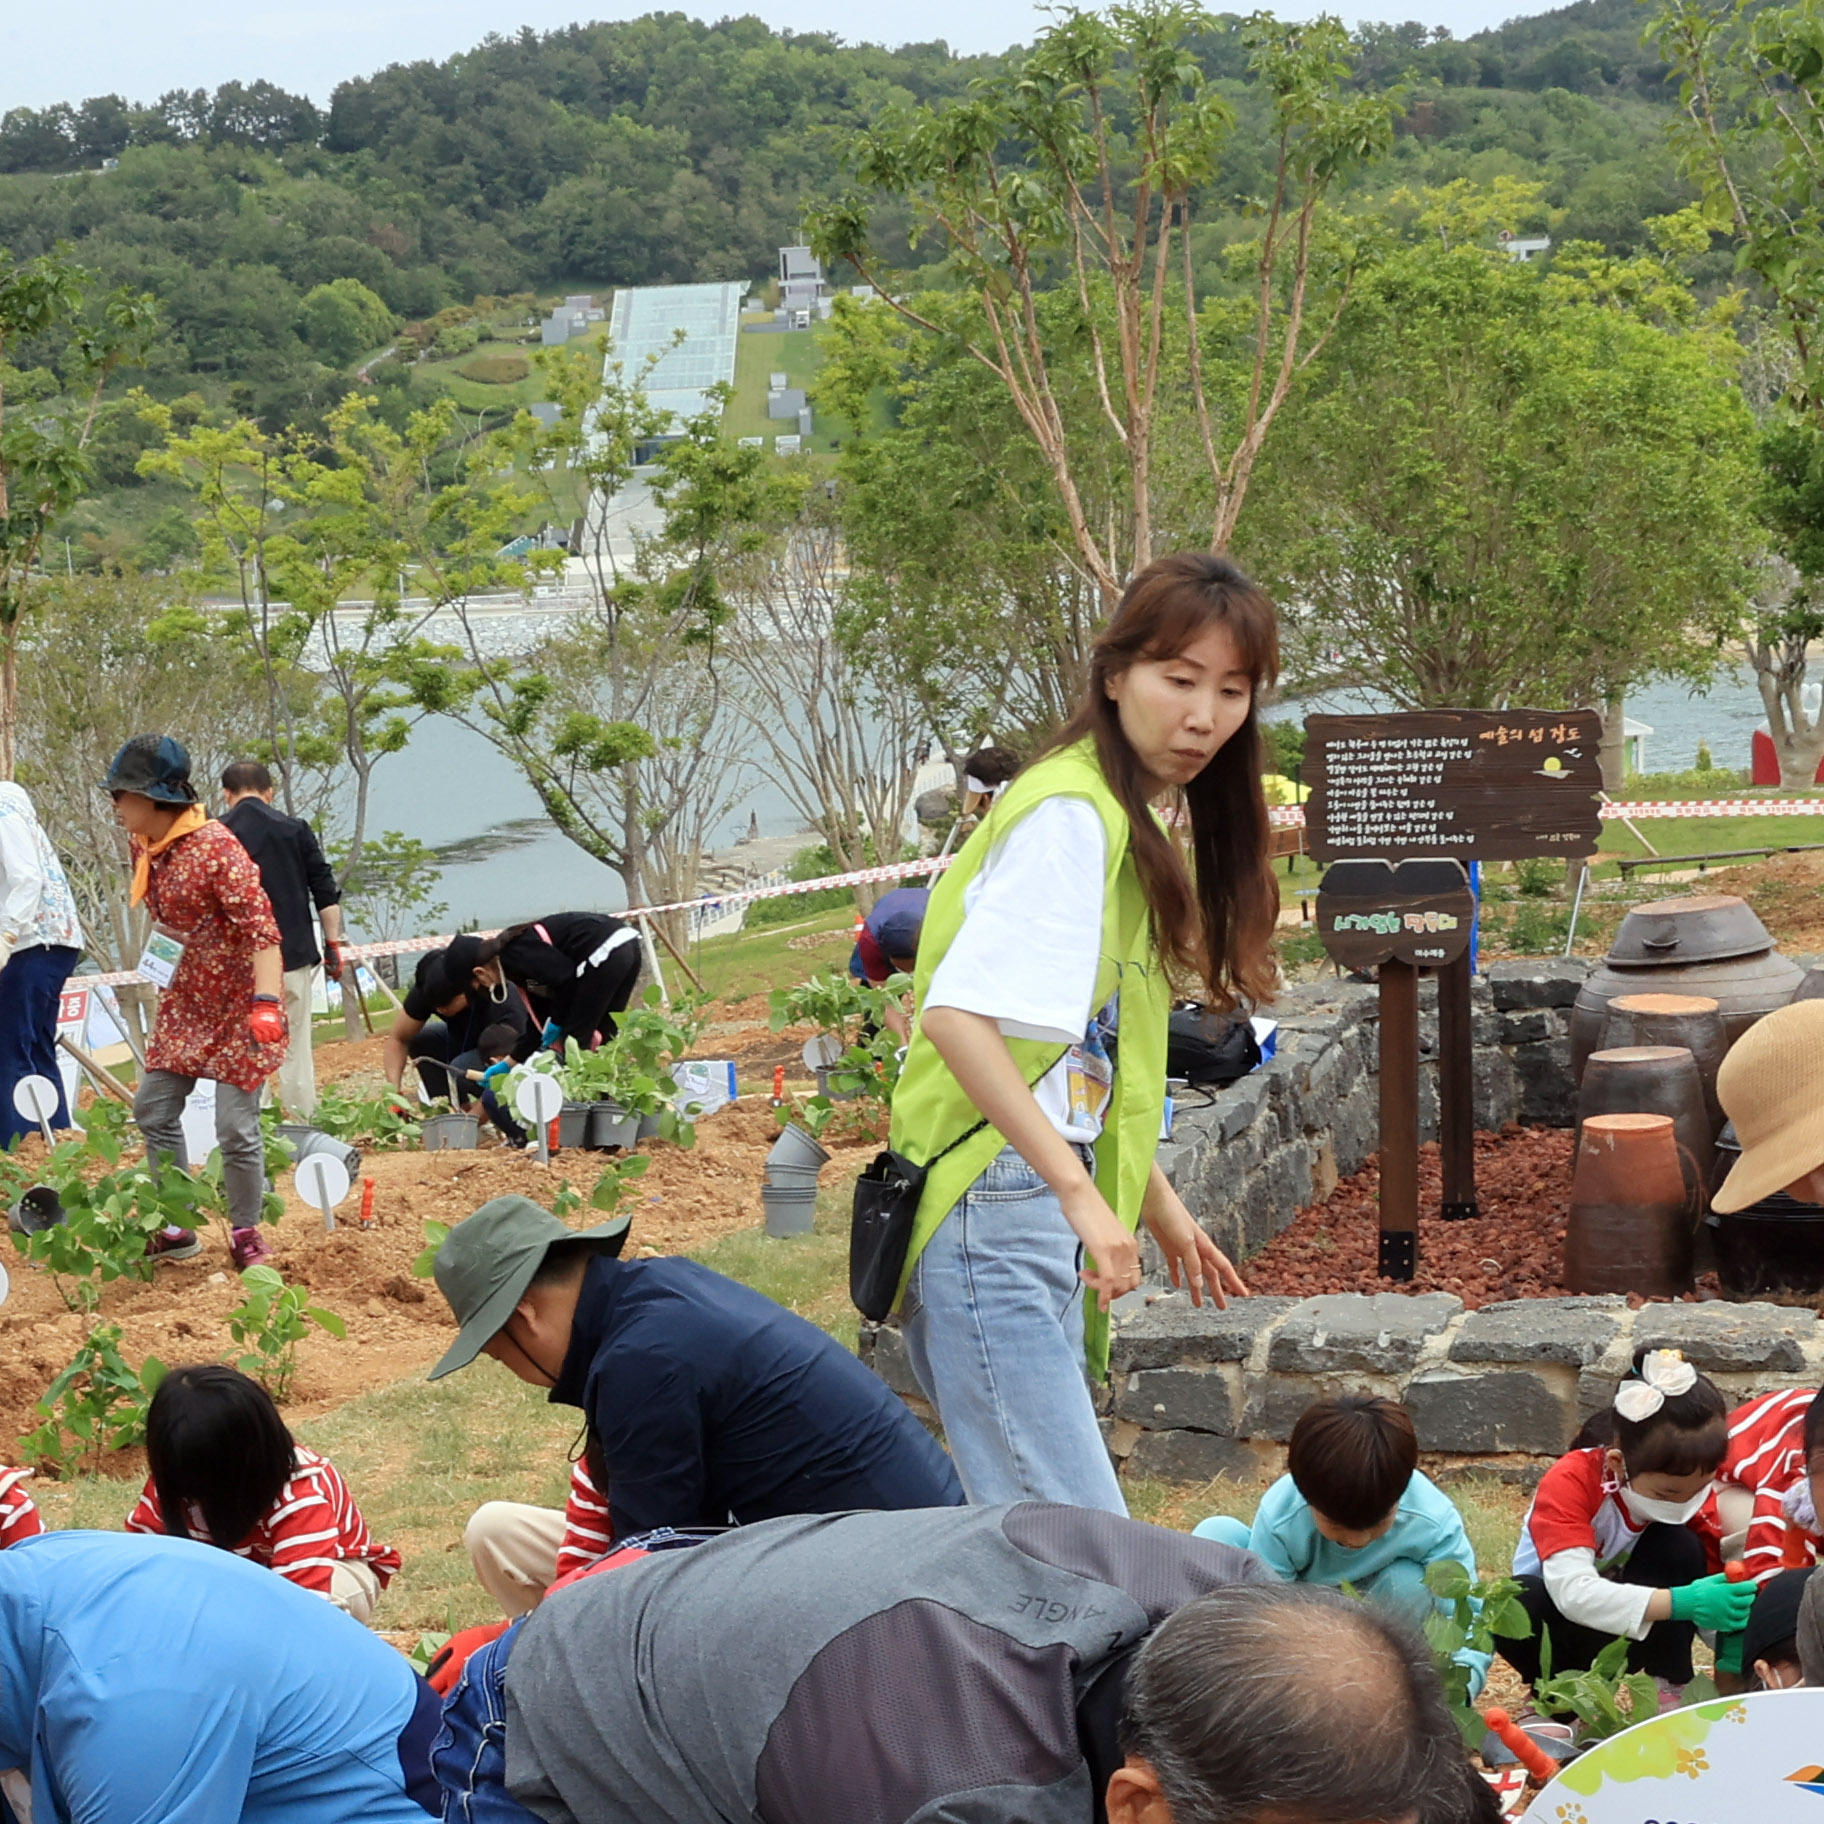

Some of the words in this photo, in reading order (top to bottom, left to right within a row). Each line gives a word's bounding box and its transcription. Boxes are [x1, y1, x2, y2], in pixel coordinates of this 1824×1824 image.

[1479, 725, 1523, 746] 예술의
[1528, 727, 1544, 744] 섬
[1550, 723, 1582, 745] 장도
